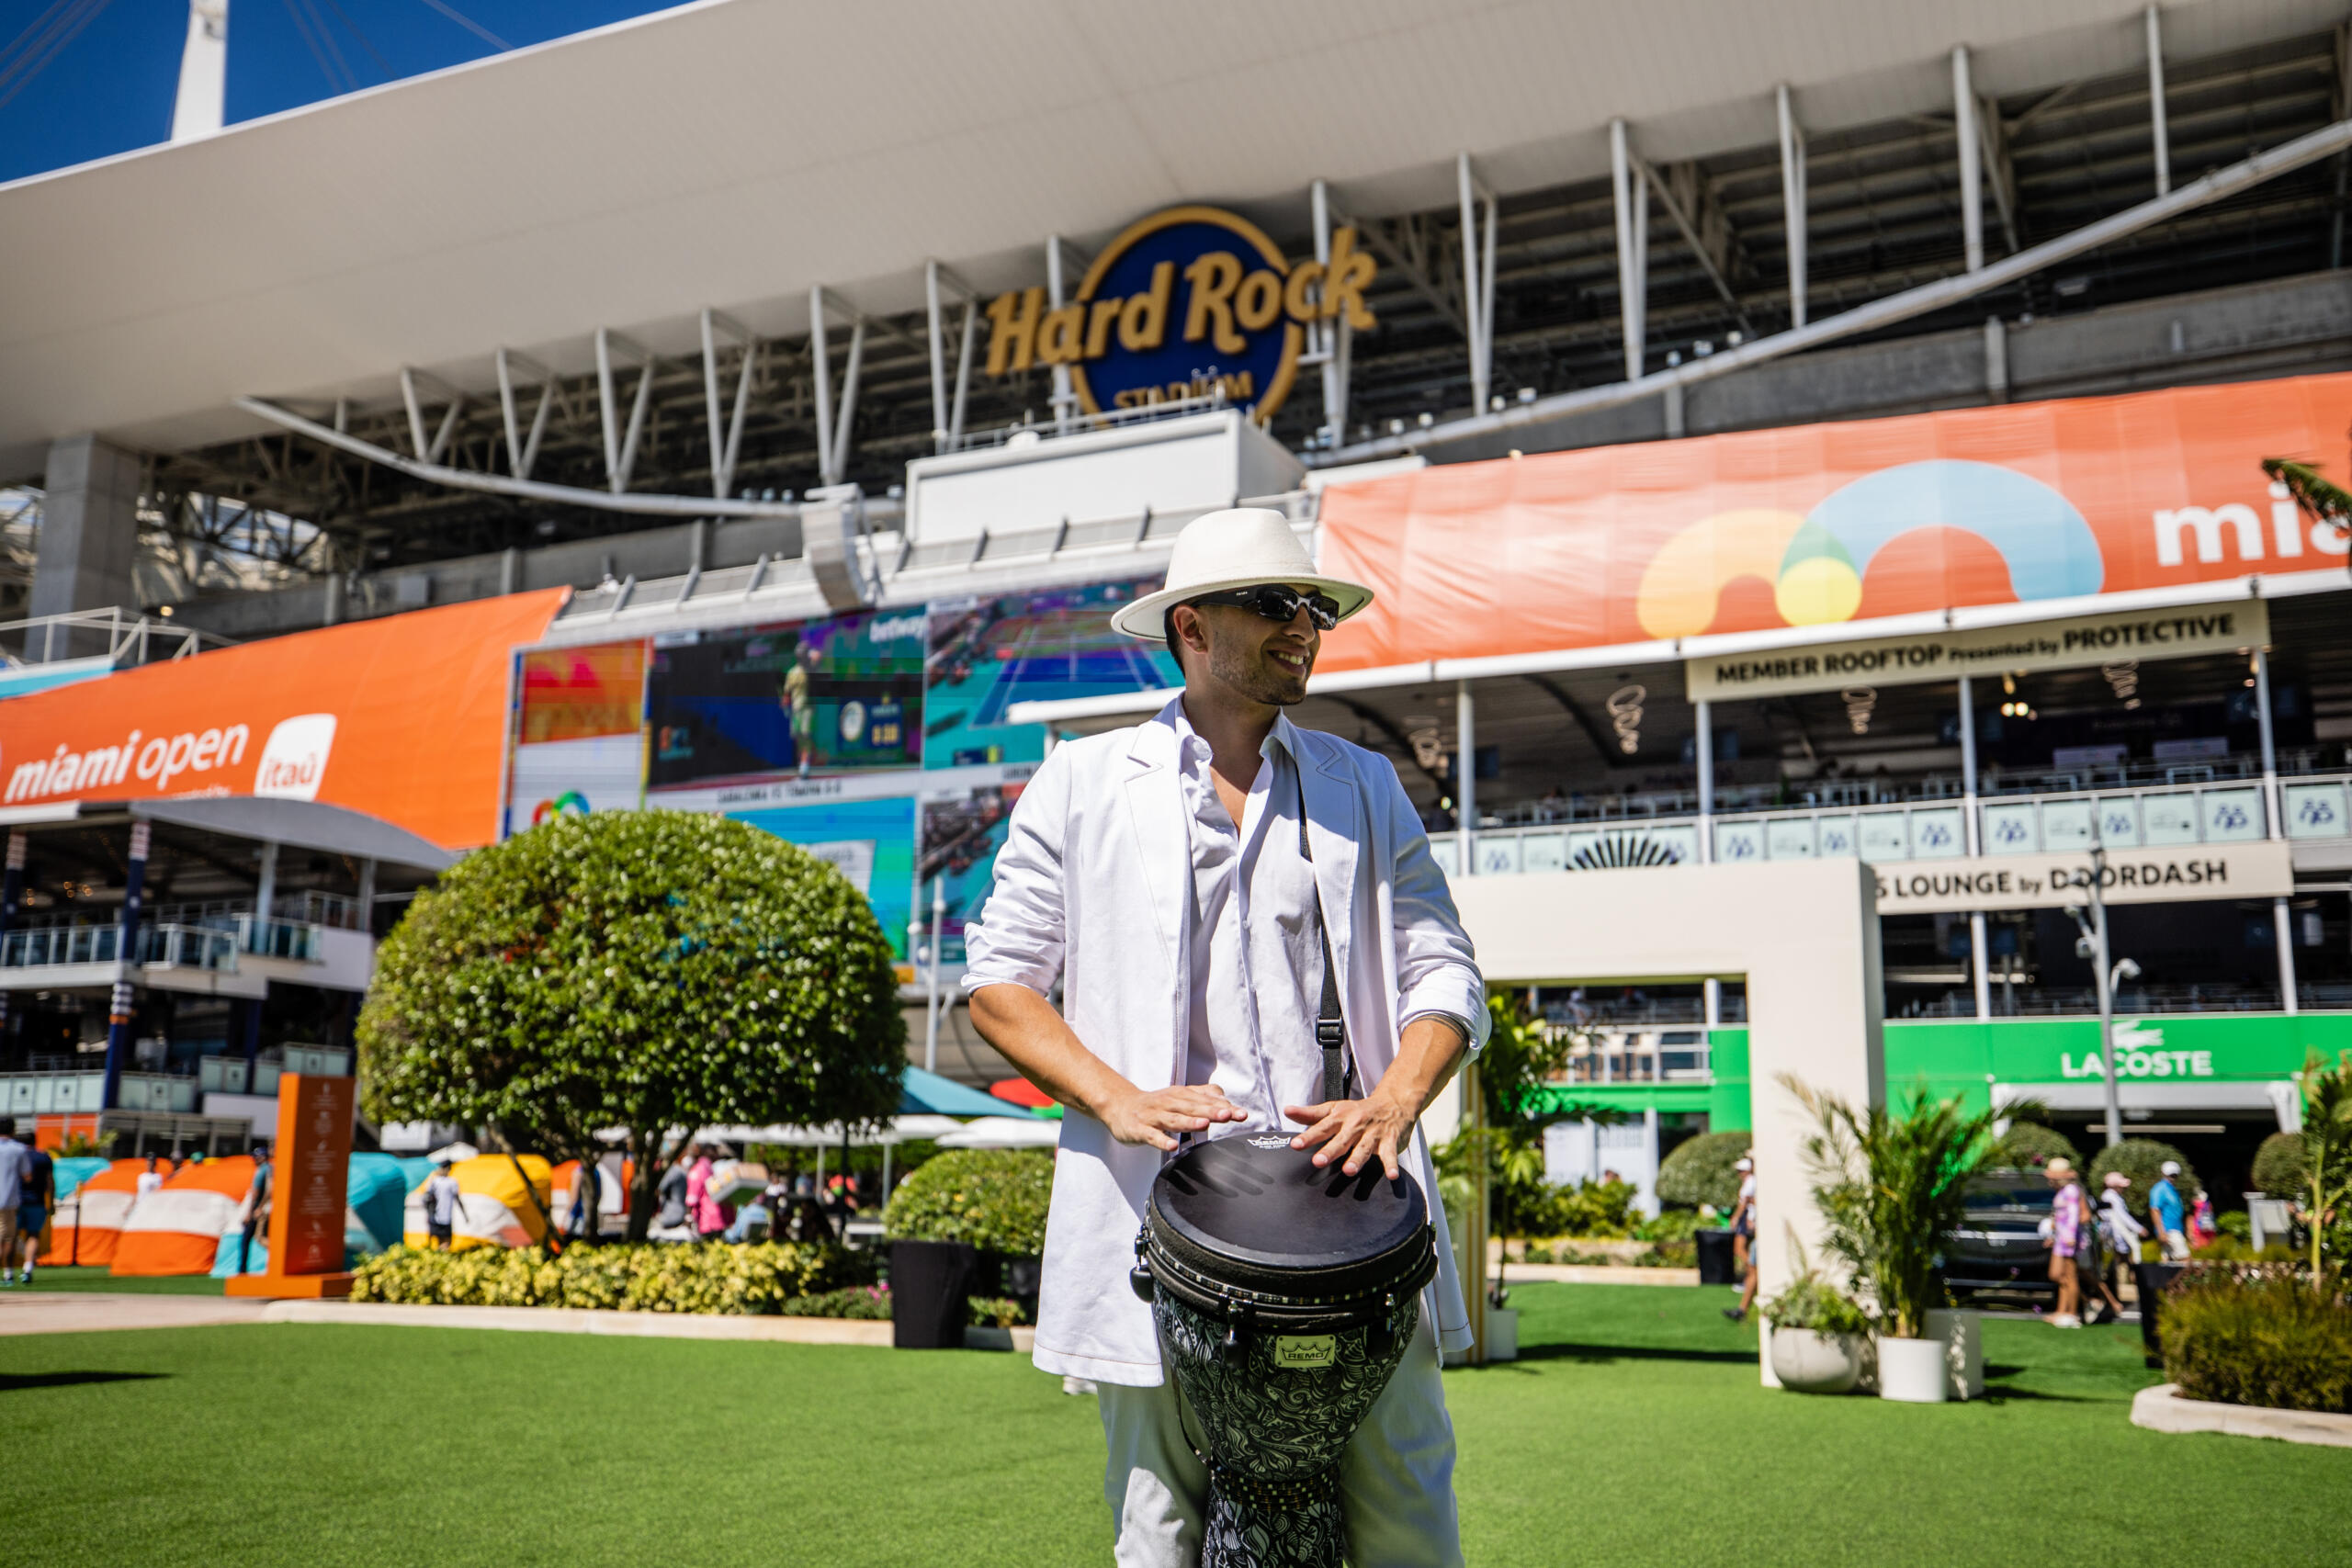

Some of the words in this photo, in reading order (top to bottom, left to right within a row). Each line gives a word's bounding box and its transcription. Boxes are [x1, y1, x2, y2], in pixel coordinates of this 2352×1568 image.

[986, 261, 1173, 376] Hard
[1183, 226, 1377, 354] Rock
[1114, 370, 1254, 408] STADIM
[1716, 655, 1819, 683] MEMBER
[1824, 643, 1943, 673] ROOFTOP
[1949, 640, 2036, 661] Presented
[2038, 637, 2060, 657] by
[2063, 613, 2235, 650] PROTECTIVE
[4, 728, 142, 804] miami
[136, 724, 250, 791] open
[1895, 871, 2011, 897] LOUNGE
[2019, 874, 2042, 896] by
[2050, 859, 2227, 892] DOORDASH
[2061, 1050, 2214, 1078] LACOSTE
